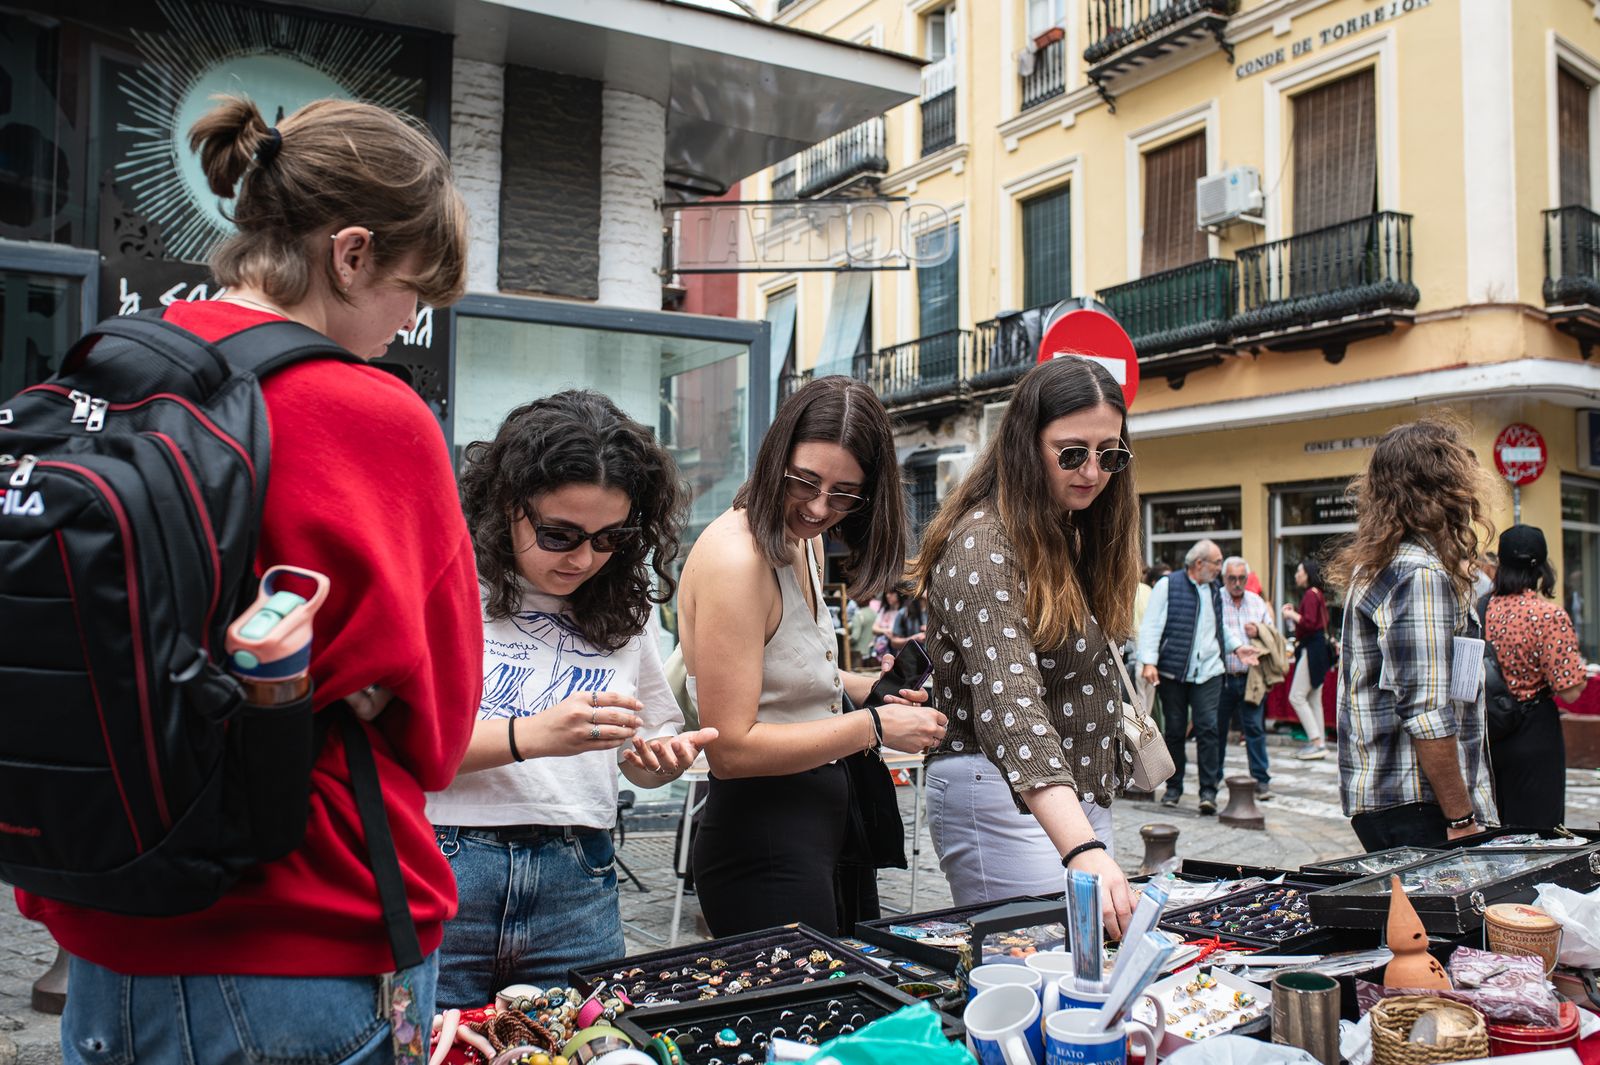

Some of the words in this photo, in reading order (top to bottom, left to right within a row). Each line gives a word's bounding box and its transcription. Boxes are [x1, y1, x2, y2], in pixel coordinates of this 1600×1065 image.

[1236, 48, 1285, 78] CONDE
[1292, 37, 1312, 56] DE
[666, 202, 952, 265] TATTOO
